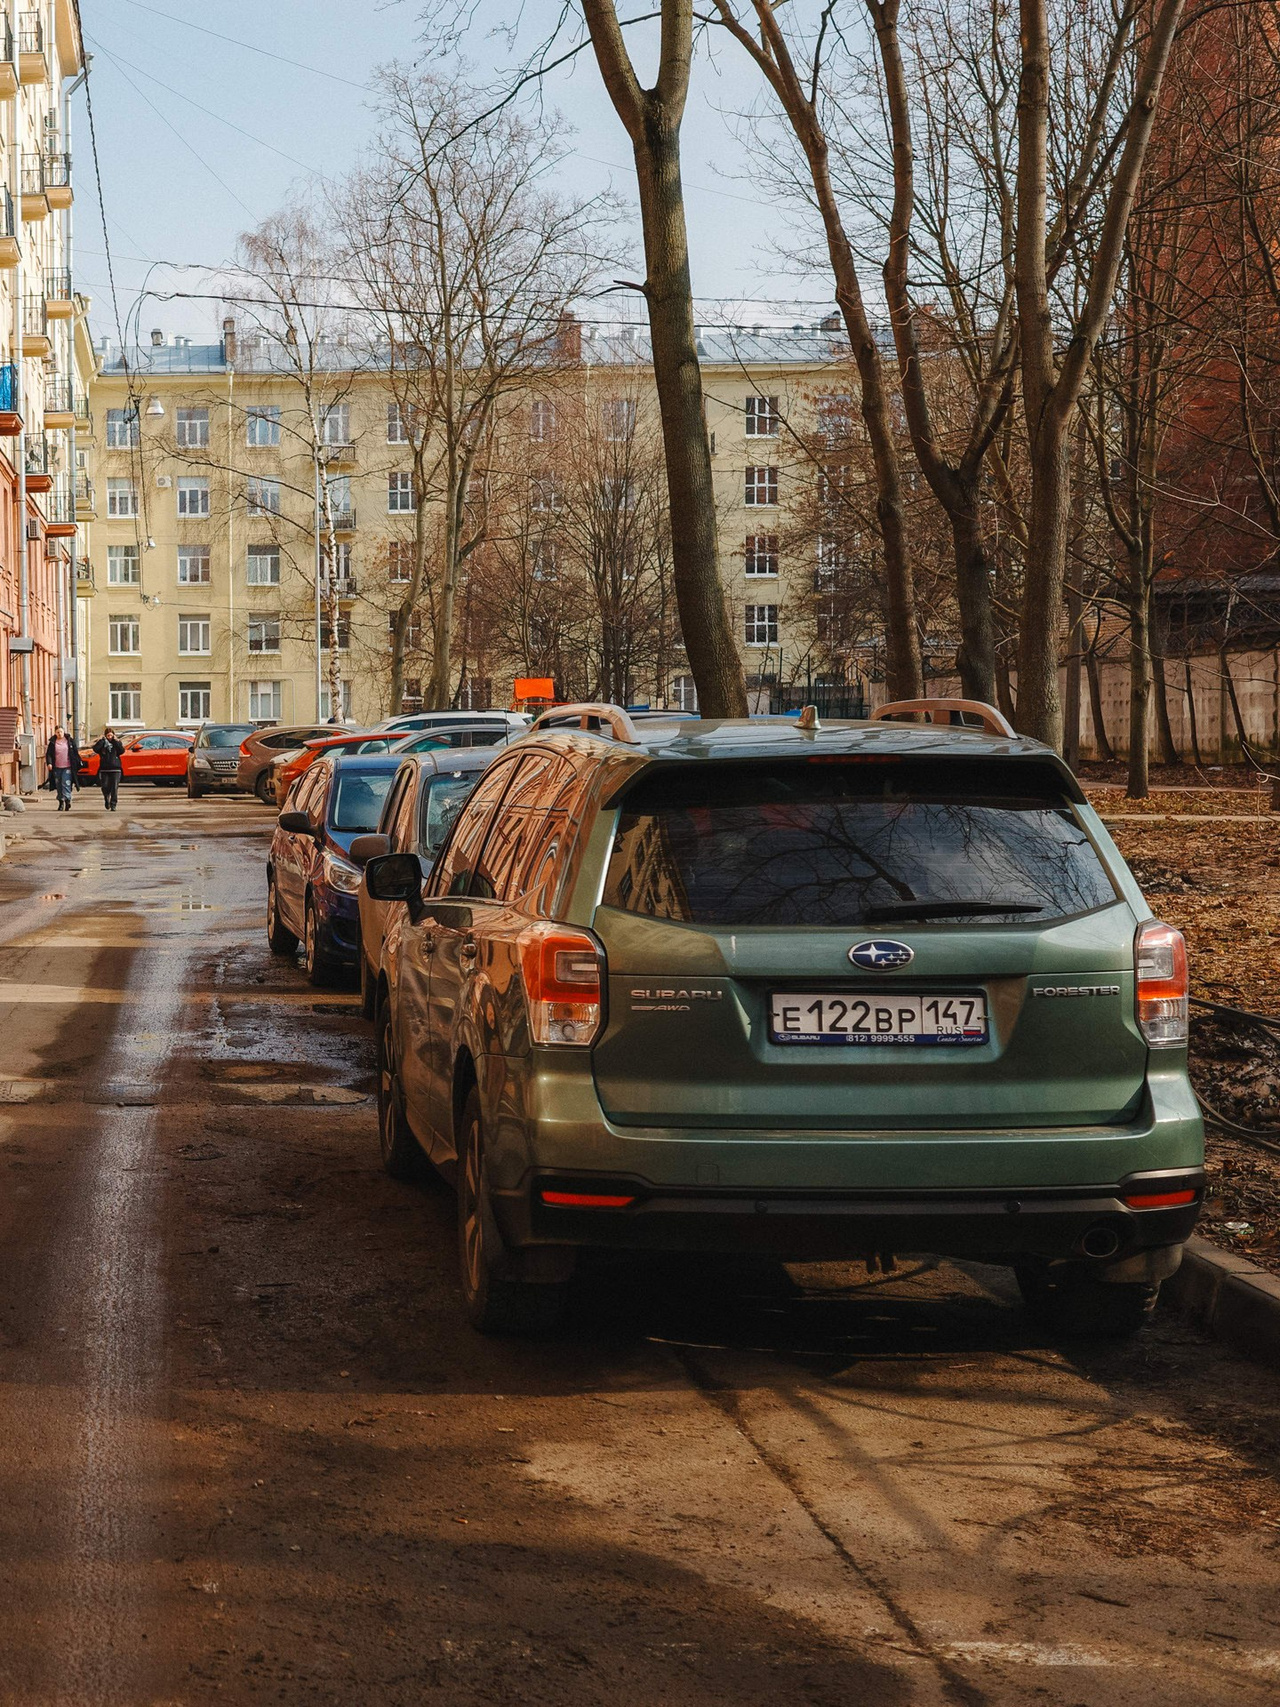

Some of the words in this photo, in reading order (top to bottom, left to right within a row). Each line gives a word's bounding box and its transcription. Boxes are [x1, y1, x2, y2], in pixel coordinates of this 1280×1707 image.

[630, 988, 723, 1000] SUBARU
[1032, 985, 1121, 997] FORESTER
[925, 1000, 975, 1026] 147
[936, 1025, 962, 1035] RUS
[845, 1034, 868, 1043] (812)
[870, 1034, 916, 1043] 9999-555
